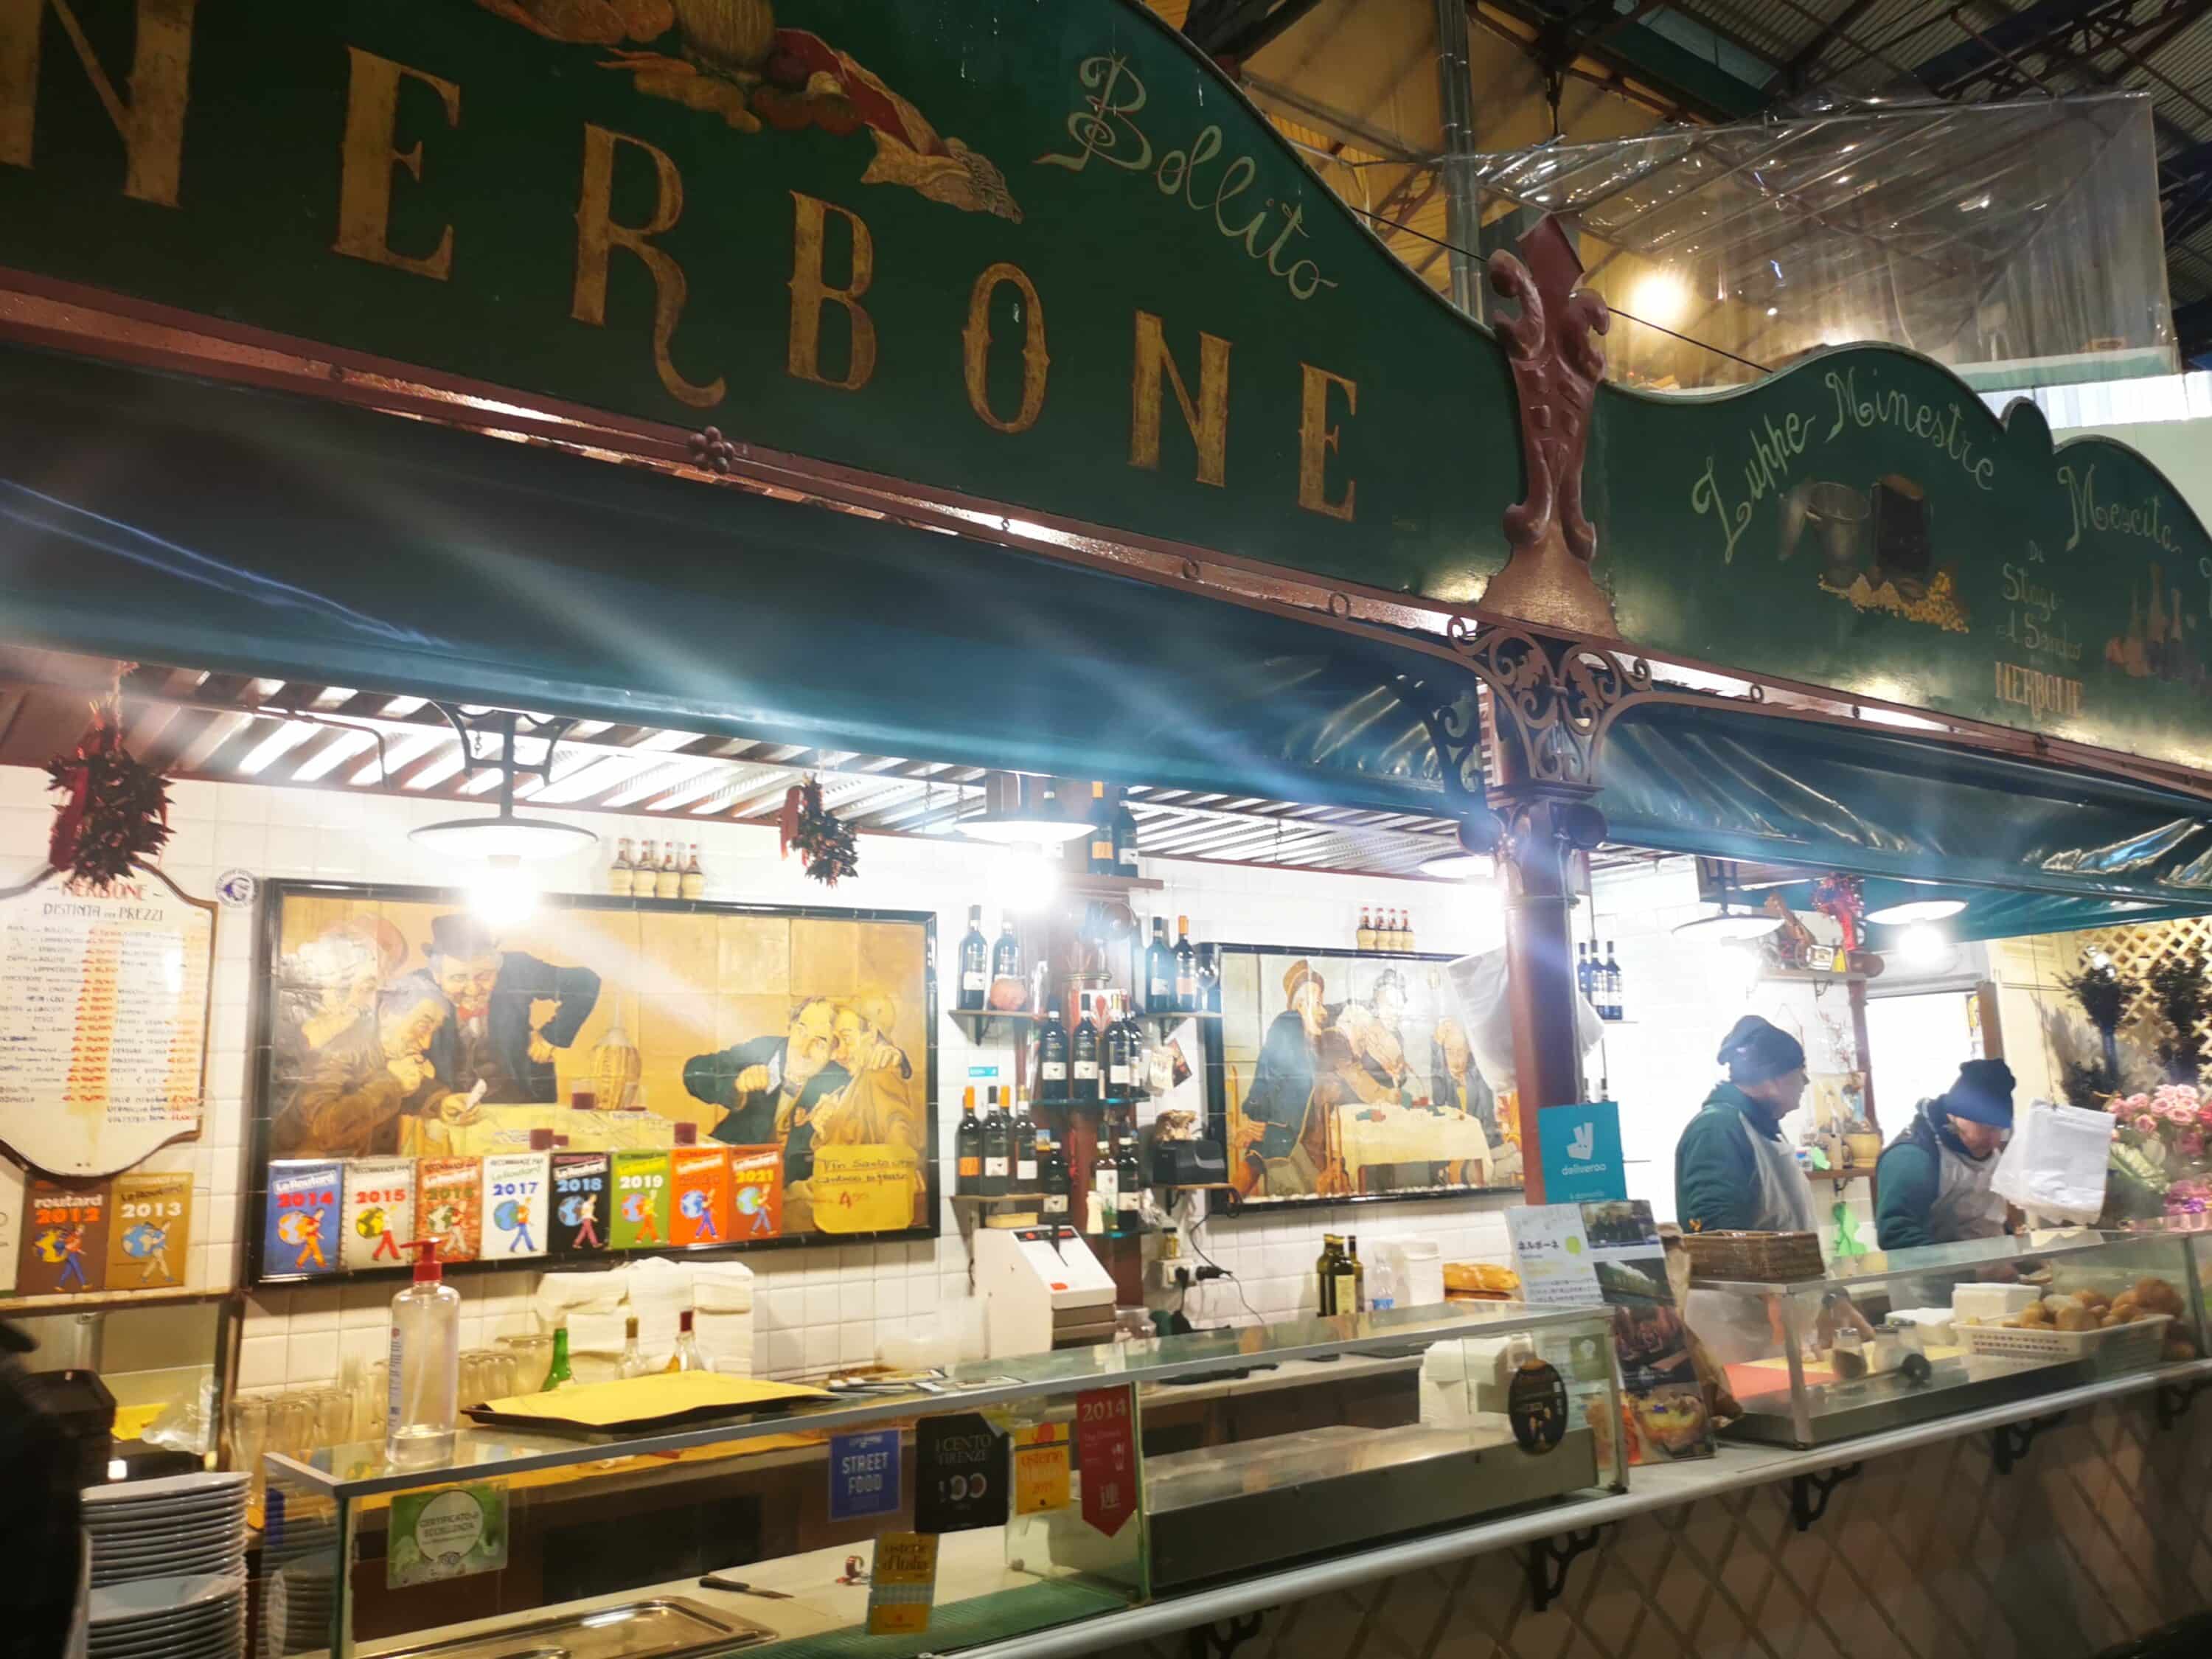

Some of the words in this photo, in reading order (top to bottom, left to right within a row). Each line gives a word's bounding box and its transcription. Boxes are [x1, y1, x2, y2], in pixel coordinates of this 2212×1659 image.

[1032, 52, 1338, 299] Bollito
[0, 0, 1357, 522] NERBONE
[119, 908, 164, 922] PREZZI
[735, 1168, 774, 1183] 2021
[1561, 1163, 1607, 1176] deliveroo
[493, 1182, 539, 1196] 2017
[556, 1177, 603, 1192] 2018
[619, 1175, 664, 1189] 2019
[277, 1191, 335, 1208] 2014
[355, 1189, 407, 1204] 2015
[120, 1202, 182, 1218] 2013
[1082, 1398, 1127, 1423] 2014
[841, 1451, 889, 1475] STREET
[849, 1474, 883, 1495] FOOD
